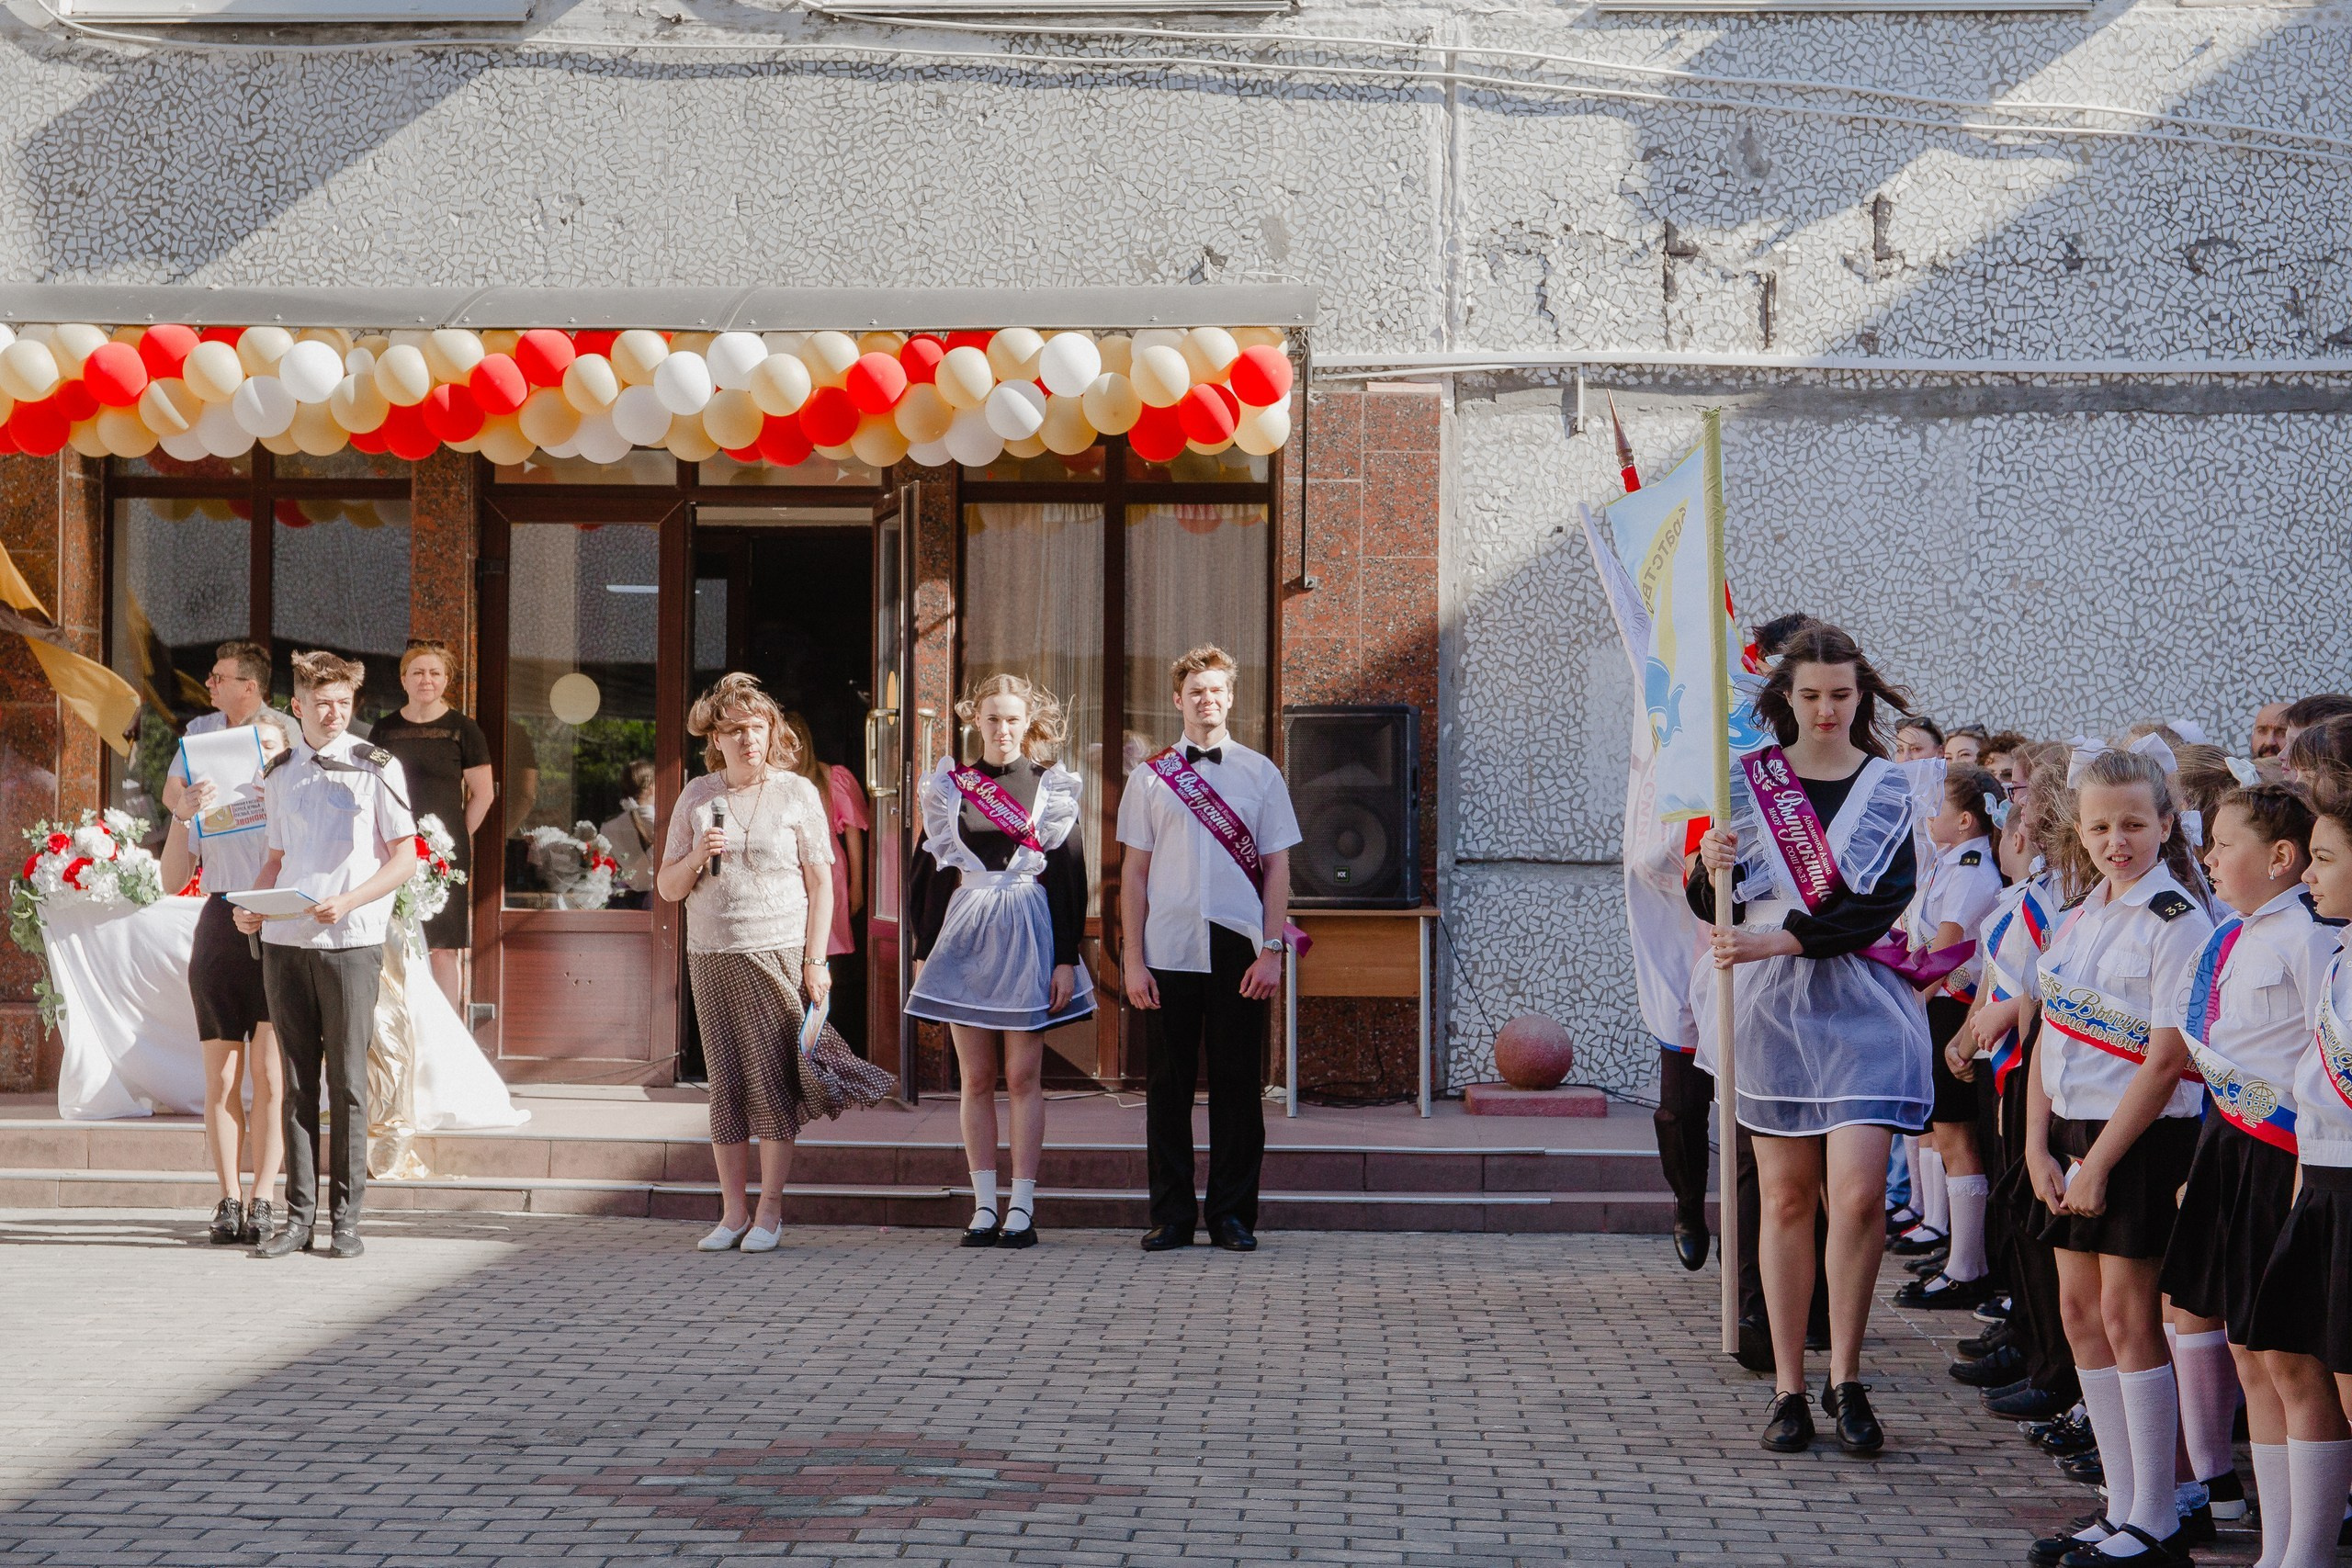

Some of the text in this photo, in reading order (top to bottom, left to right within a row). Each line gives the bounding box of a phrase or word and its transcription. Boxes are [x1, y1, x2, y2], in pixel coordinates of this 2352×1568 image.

[1174, 771, 1238, 840] Выпускник
[1768, 807, 1808, 884] МАОУ СОШ №33
[1803, 815, 1832, 875] Адаменко Алина
[2165, 901, 2188, 916] 33
